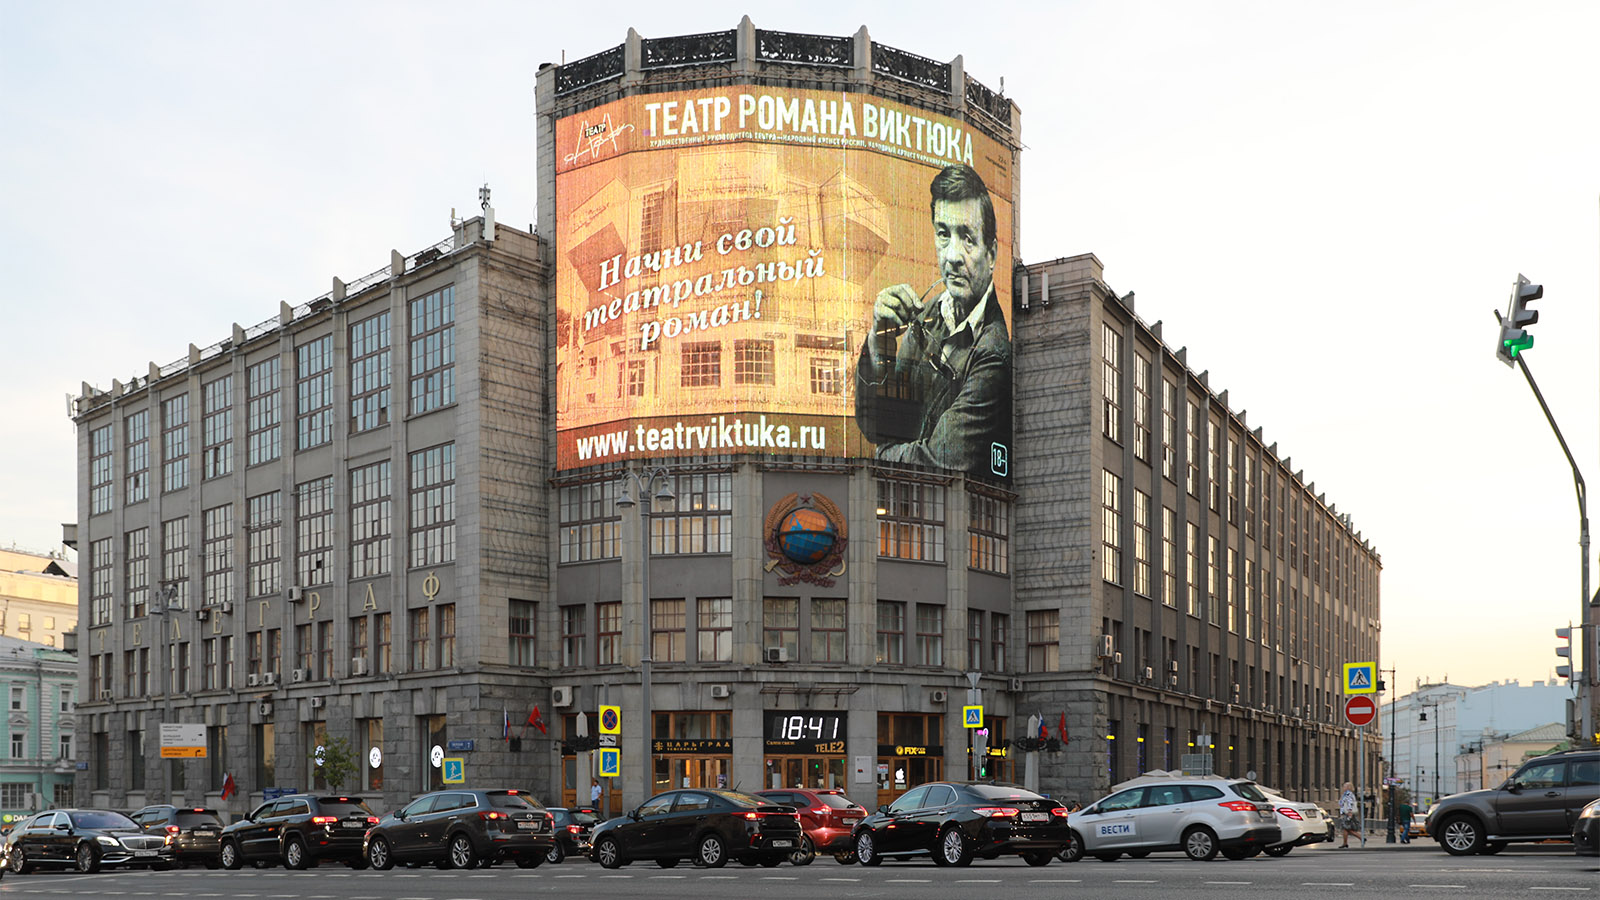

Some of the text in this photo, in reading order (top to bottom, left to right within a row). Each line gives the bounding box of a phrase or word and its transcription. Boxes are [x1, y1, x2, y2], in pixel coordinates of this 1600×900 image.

[585, 124, 606, 136] ТЕАТР
[645, 95, 731, 137] ТЕАТР
[739, 94, 857, 136] РОМАНА
[863, 103, 974, 168] ВИКТЮКА
[597, 216, 797, 291] Начни свой
[584, 248, 826, 331] театральный
[640, 289, 762, 351] роман!
[577, 415, 826, 460] www.teatrviktuka.ru
[781, 716, 839, 739] 18:41
[815, 741, 844, 752] TELE2
[1101, 825, 1130, 835] ВЕСТИ
